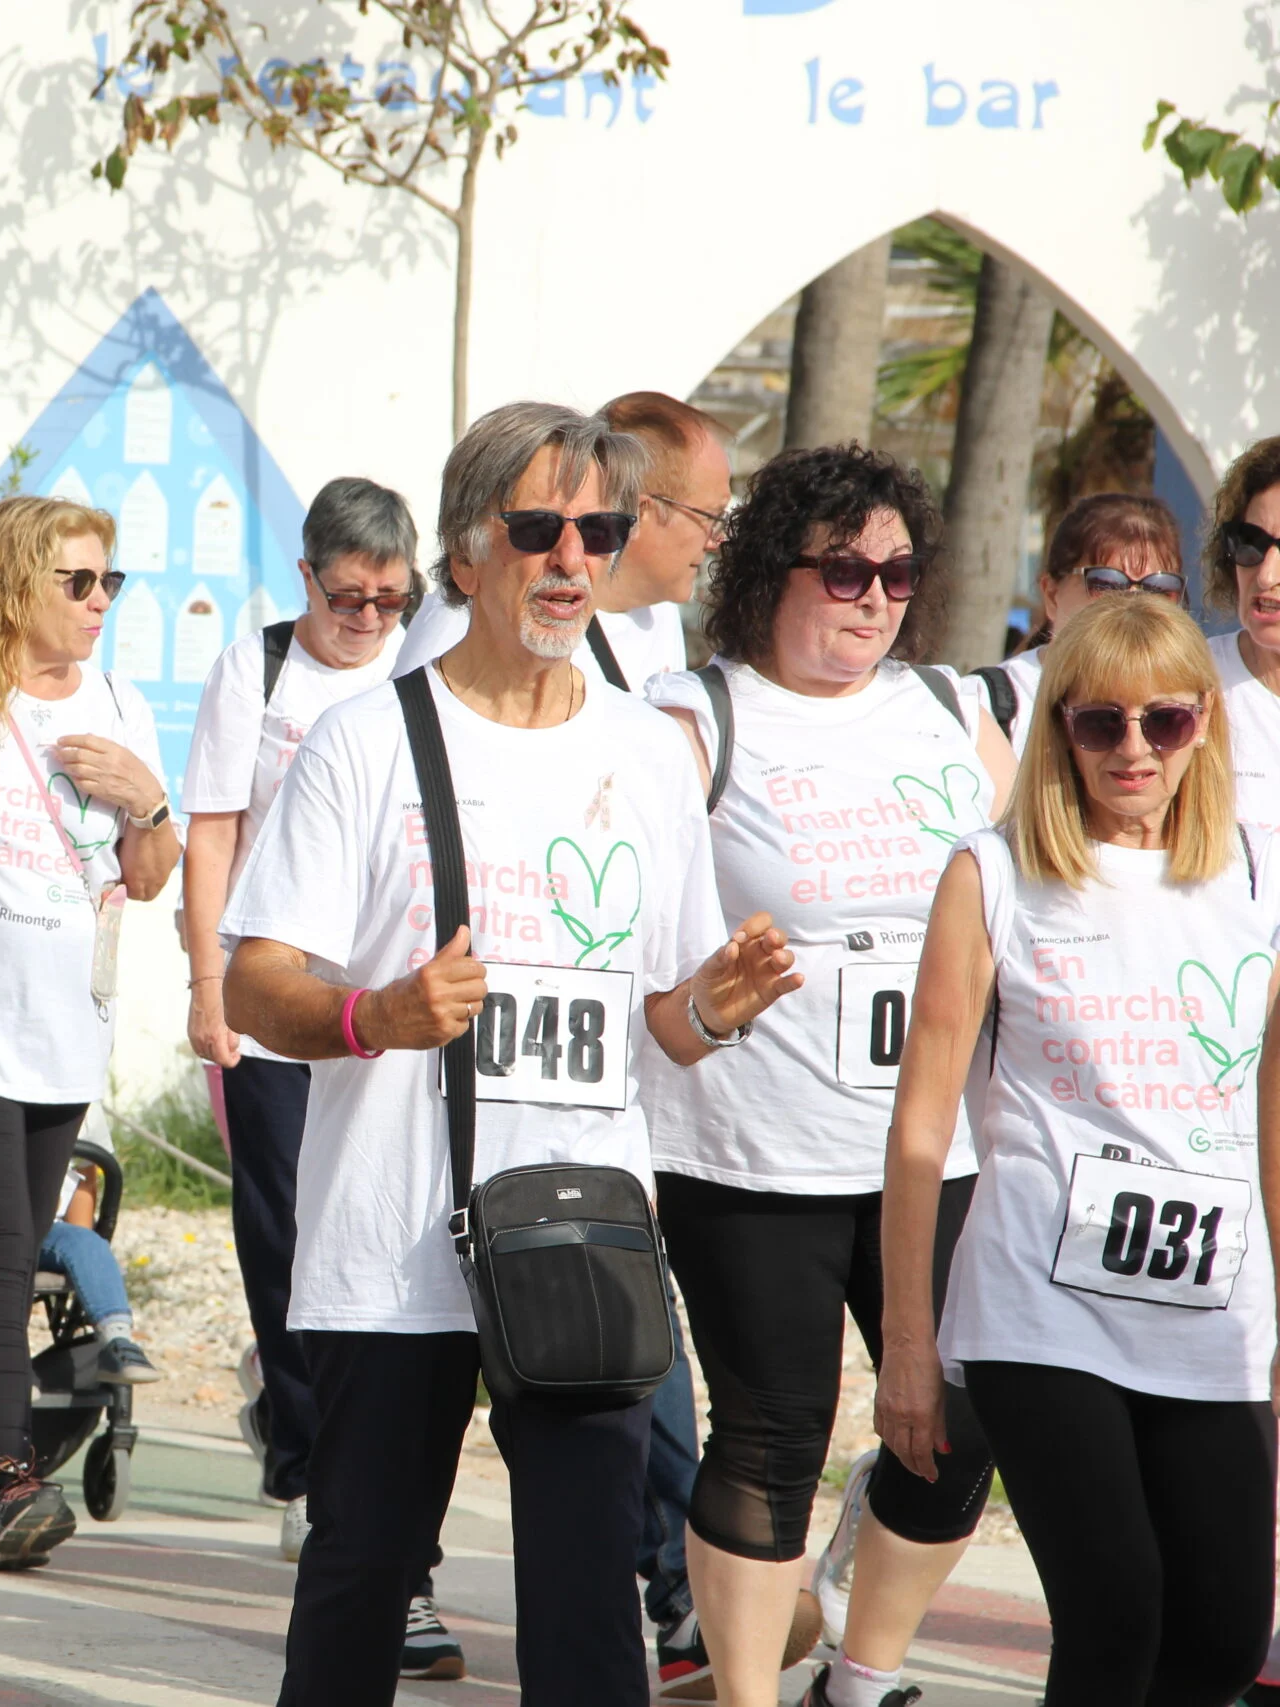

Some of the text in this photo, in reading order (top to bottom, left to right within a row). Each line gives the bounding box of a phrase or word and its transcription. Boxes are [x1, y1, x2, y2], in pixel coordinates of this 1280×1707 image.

[92, 32, 154, 102] le
[804, 56, 1061, 129] le bar
[766, 774, 818, 808] En
[780, 796, 929, 835] marcha
[789, 833, 921, 865] contra
[789, 865, 939, 904] el cánc
[406, 901, 543, 944] cntra
[880, 930, 926, 945] Rimon
[1037, 936, 1072, 945] MARCHA
[1086, 933, 1111, 942] XABIA
[1032, 947, 1085, 983] En
[1034, 985, 1204, 1024] marcha
[476, 992, 606, 1084] 048
[1041, 1030, 1180, 1067] contra
[1051, 1070, 1240, 1112] el cáncer
[1101, 1190, 1224, 1286] 031
